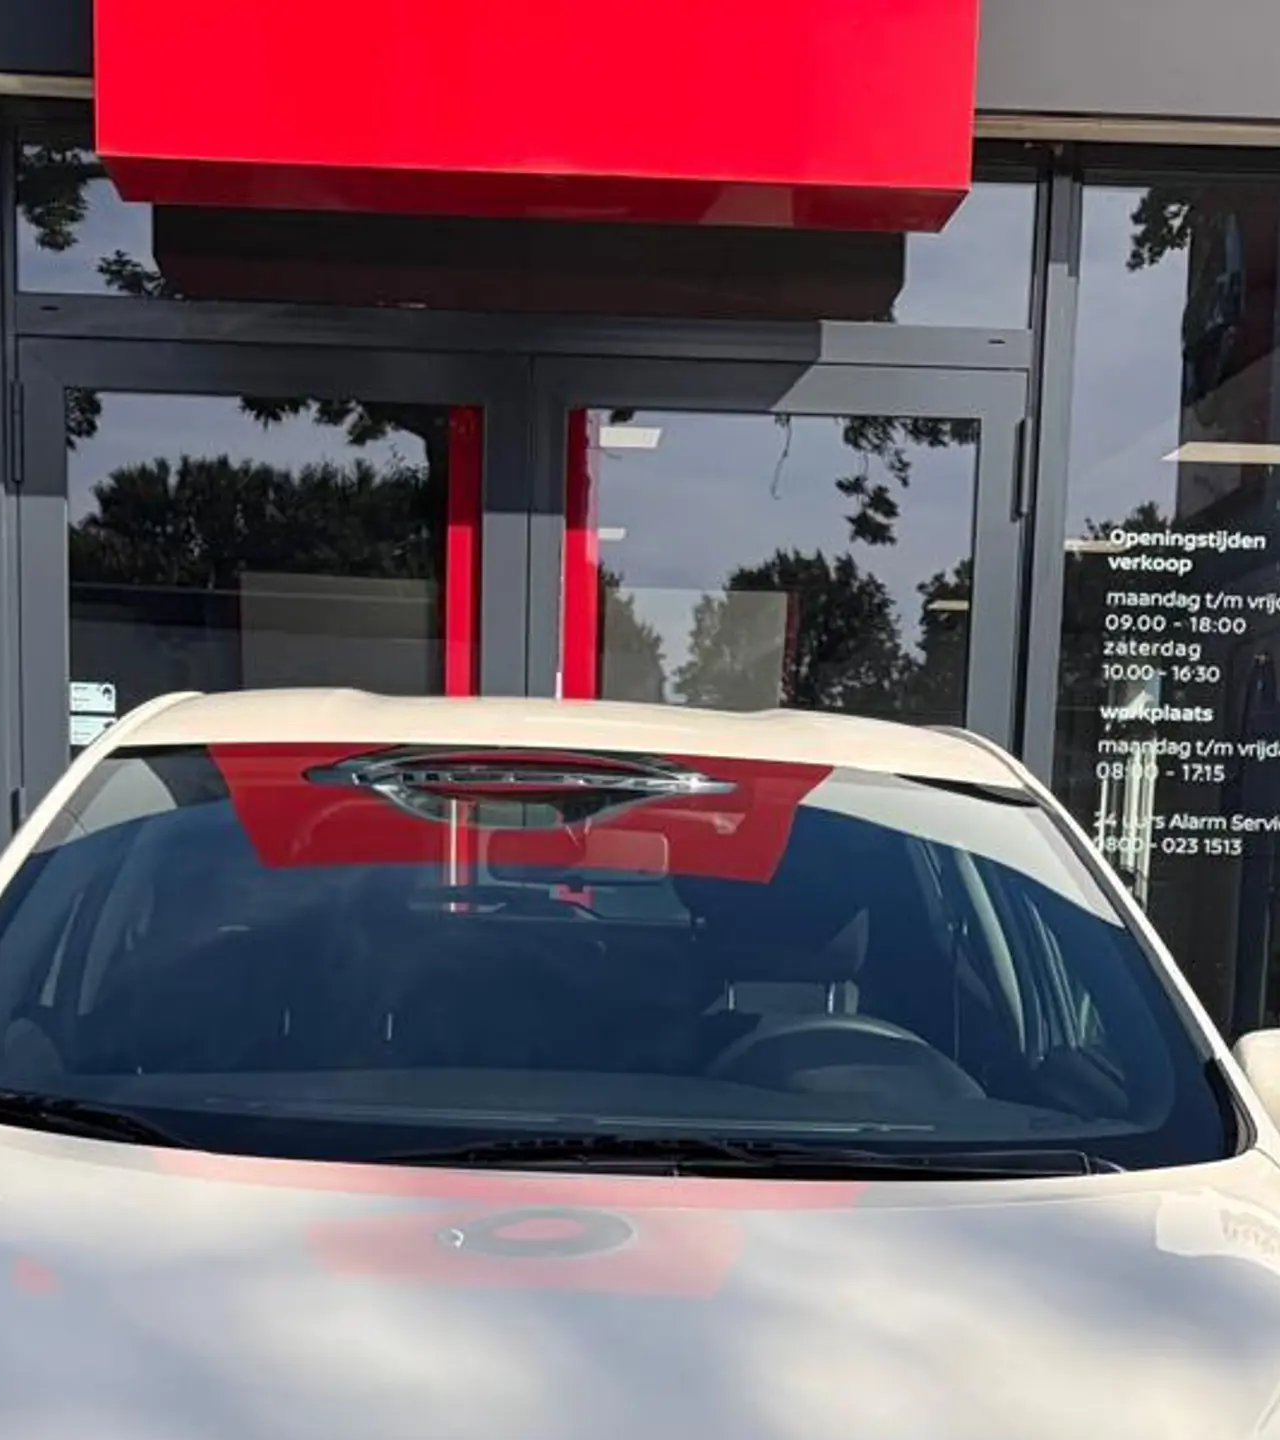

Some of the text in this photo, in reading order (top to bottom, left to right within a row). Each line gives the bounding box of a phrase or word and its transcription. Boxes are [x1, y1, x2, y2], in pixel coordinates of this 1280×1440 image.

[1110, 529, 1266, 553] Openingstijden
[1108, 554, 1193, 576] verkoop
[1106, 591, 1200, 613] maandag
[1205, 592, 1243, 609] t/m
[1105, 614, 1166, 631] 09.00
[1190, 616, 1246, 634] 18:00
[1103, 640, 1201, 661] zaterdag
[1102, 664, 1154, 680] 10.00
[1098, 738, 1191, 759] maandag
[1196, 739, 1233, 756] t/m
[1170, 813, 1227, 830] Alarm
[1161, 837, 1198, 854] 023
[1204, 838, 1243, 855] 1513
